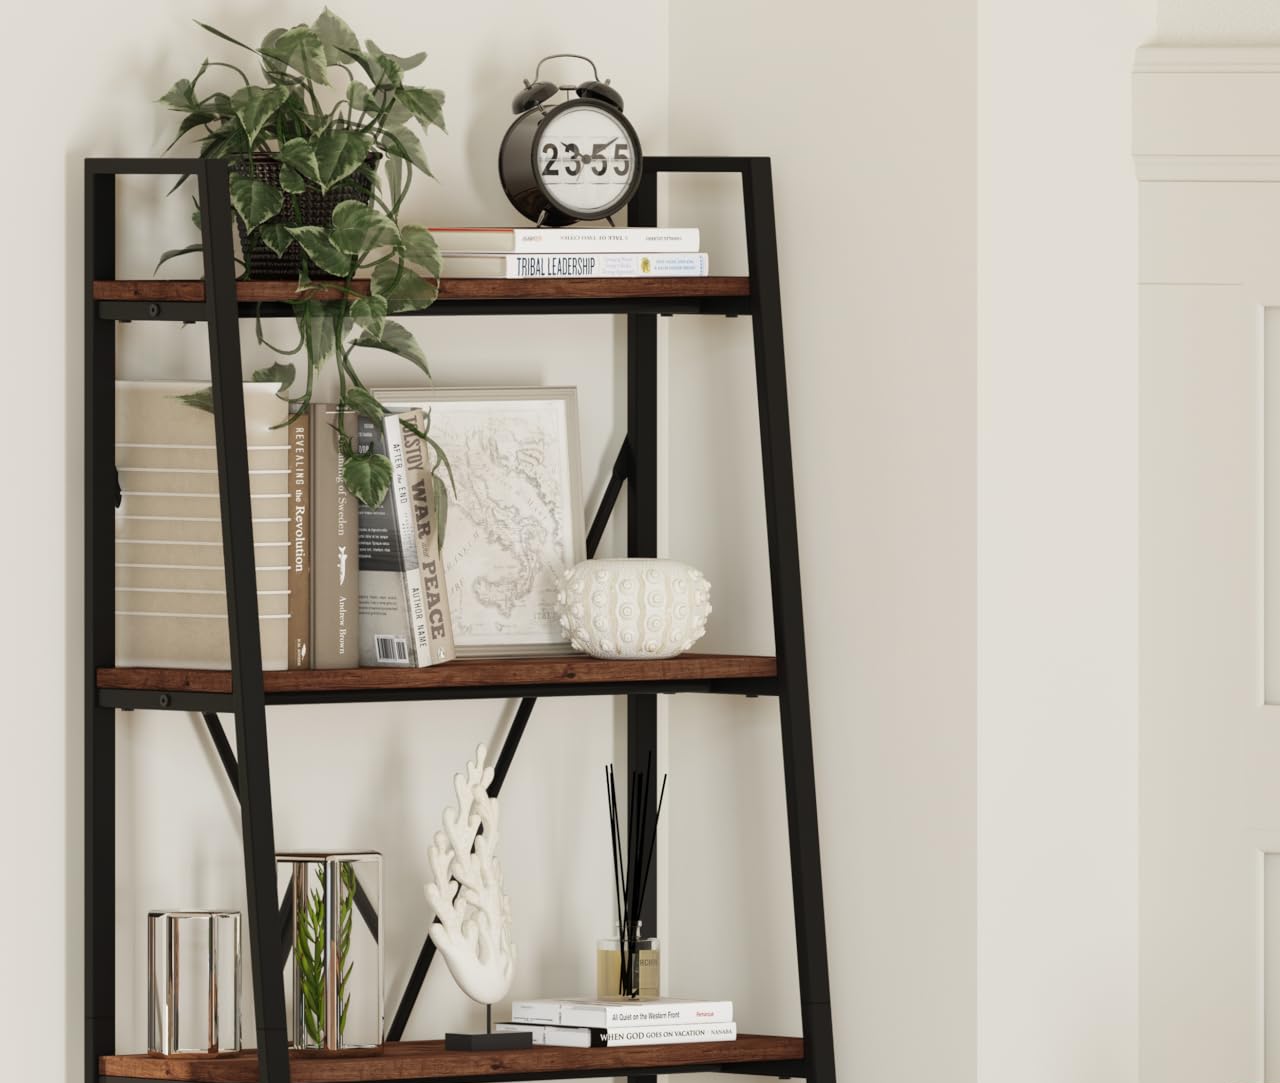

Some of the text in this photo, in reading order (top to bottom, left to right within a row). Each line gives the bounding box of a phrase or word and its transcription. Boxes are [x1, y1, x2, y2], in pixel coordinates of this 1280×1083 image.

[516, 257, 545, 276] TRIBAL
[547, 256, 596, 276] LEADERSHIP
[338, 485, 347, 496] of
[393, 443, 403, 469] AFTER
[398, 486, 408, 504] END
[295, 427, 306, 573] REVEALING the Revolution
[337, 497, 347, 537] Sweden
[411, 478, 432, 540] WAR
[422, 559, 445, 640] PEACE
[338, 595, 347, 655] Andrew Brown
[412, 586, 428, 648] AUTHOR NAME
[600, 1029, 705, 1042] WHEN GOD GOES ON VACATION
[619, 1011, 632, 1022] Quiet
[632, 1013, 639, 1021] on
[639, 1011, 648, 1020] the
[648, 1010, 667, 1020] Western
[667, 1009, 680, 1019] Front
